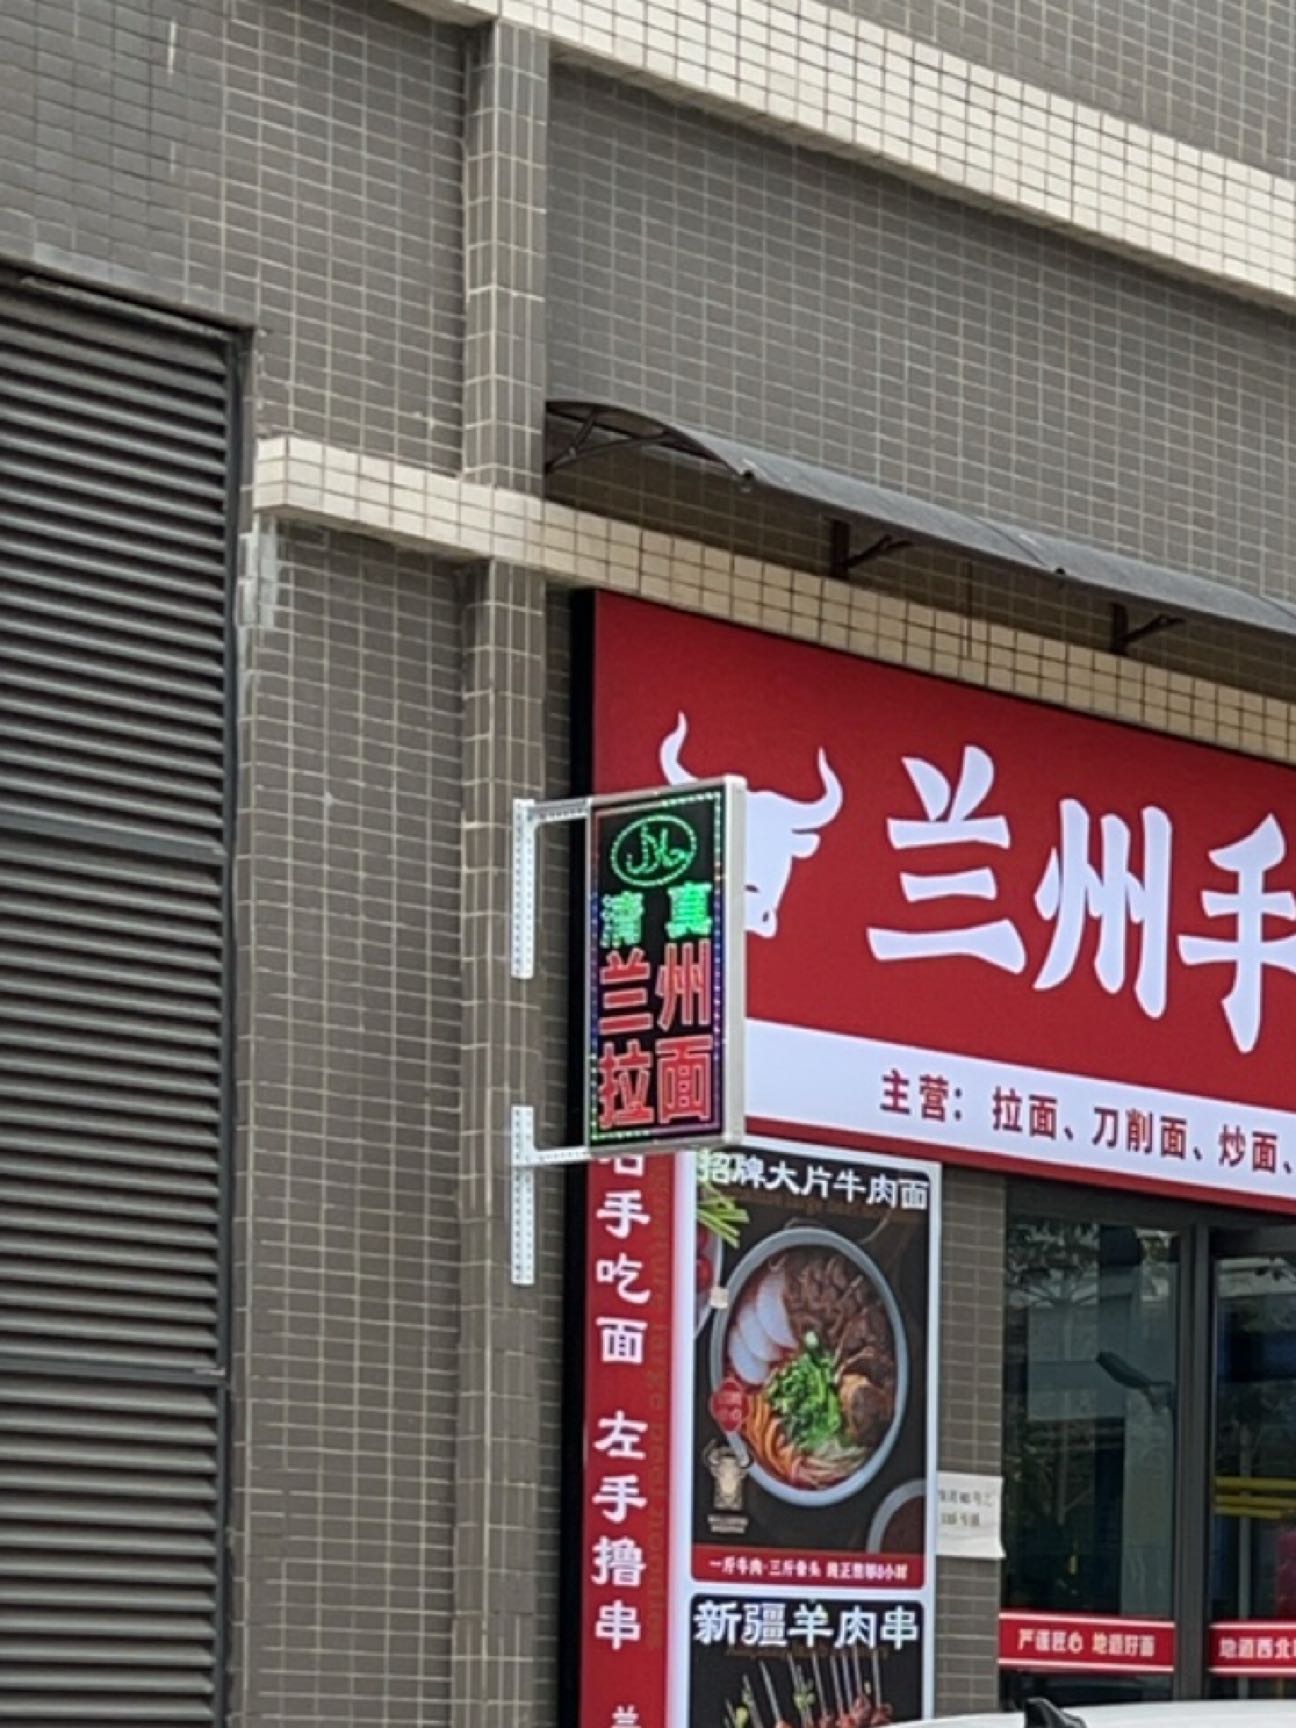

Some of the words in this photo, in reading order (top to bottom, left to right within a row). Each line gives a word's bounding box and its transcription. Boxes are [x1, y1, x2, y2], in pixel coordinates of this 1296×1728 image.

[601, 881, 713, 950] 清真
[598, 937, 712, 1036] 兰州
[598, 1035, 714, 1130] 拉面
[591, 1410, 649, 1650] 左手撸串
[693, 1600, 918, 1650] 新疆羊肉串
